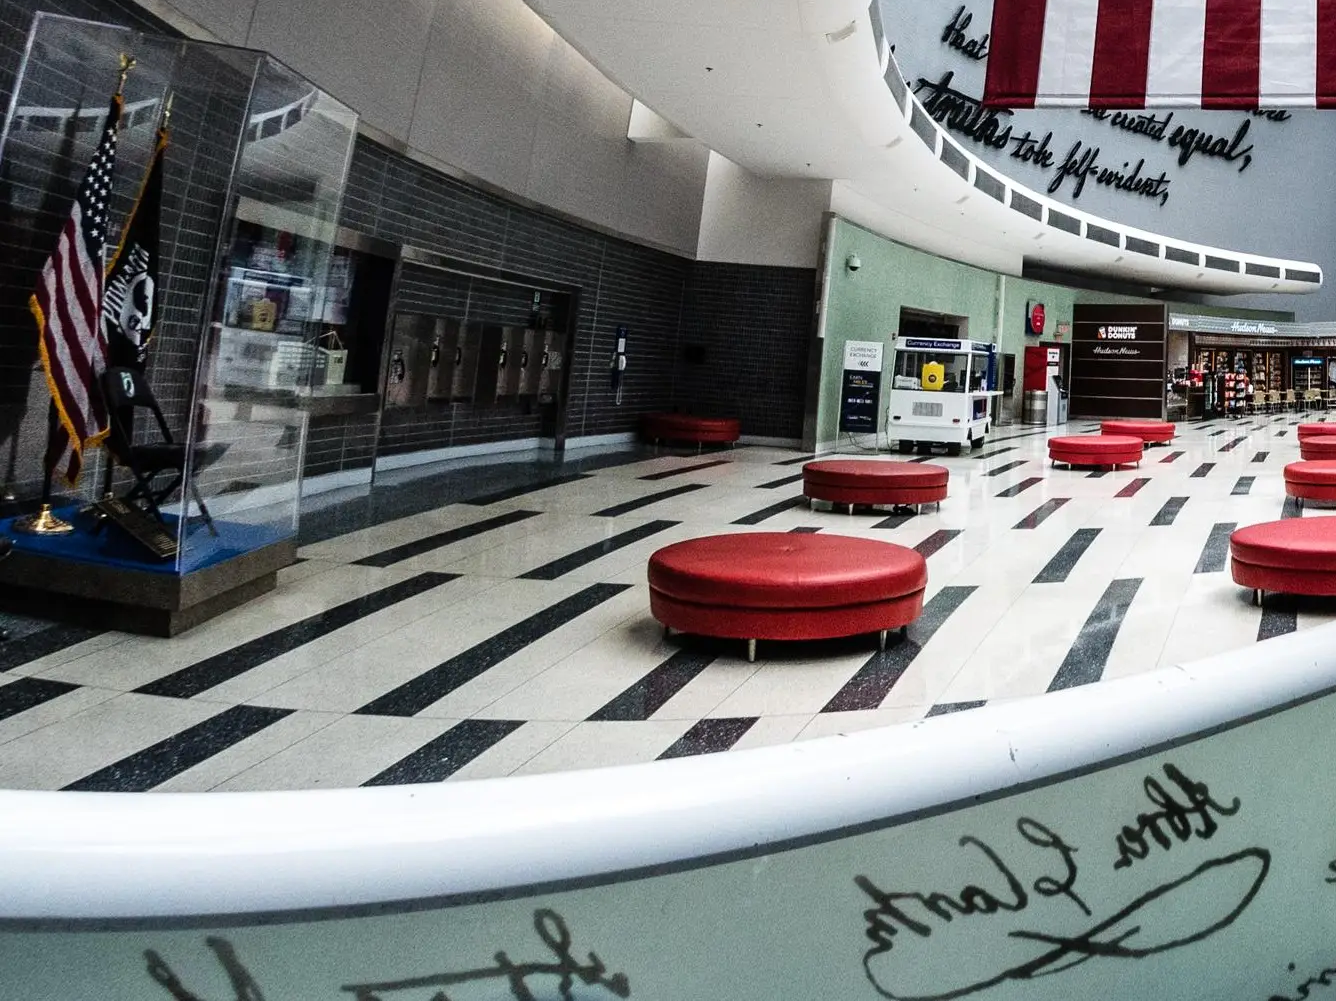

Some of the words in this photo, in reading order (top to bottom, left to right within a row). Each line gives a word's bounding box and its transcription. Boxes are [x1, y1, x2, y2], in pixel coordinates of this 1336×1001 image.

[1110, 111, 1174, 141] created
[1230, 322, 1257, 333] Hudson
[907, 339, 933, 348] Currency
[933, 341, 960, 350] Exchange
[1093, 346, 1120, 355] Hudson
[1119, 347, 1141, 355] News
